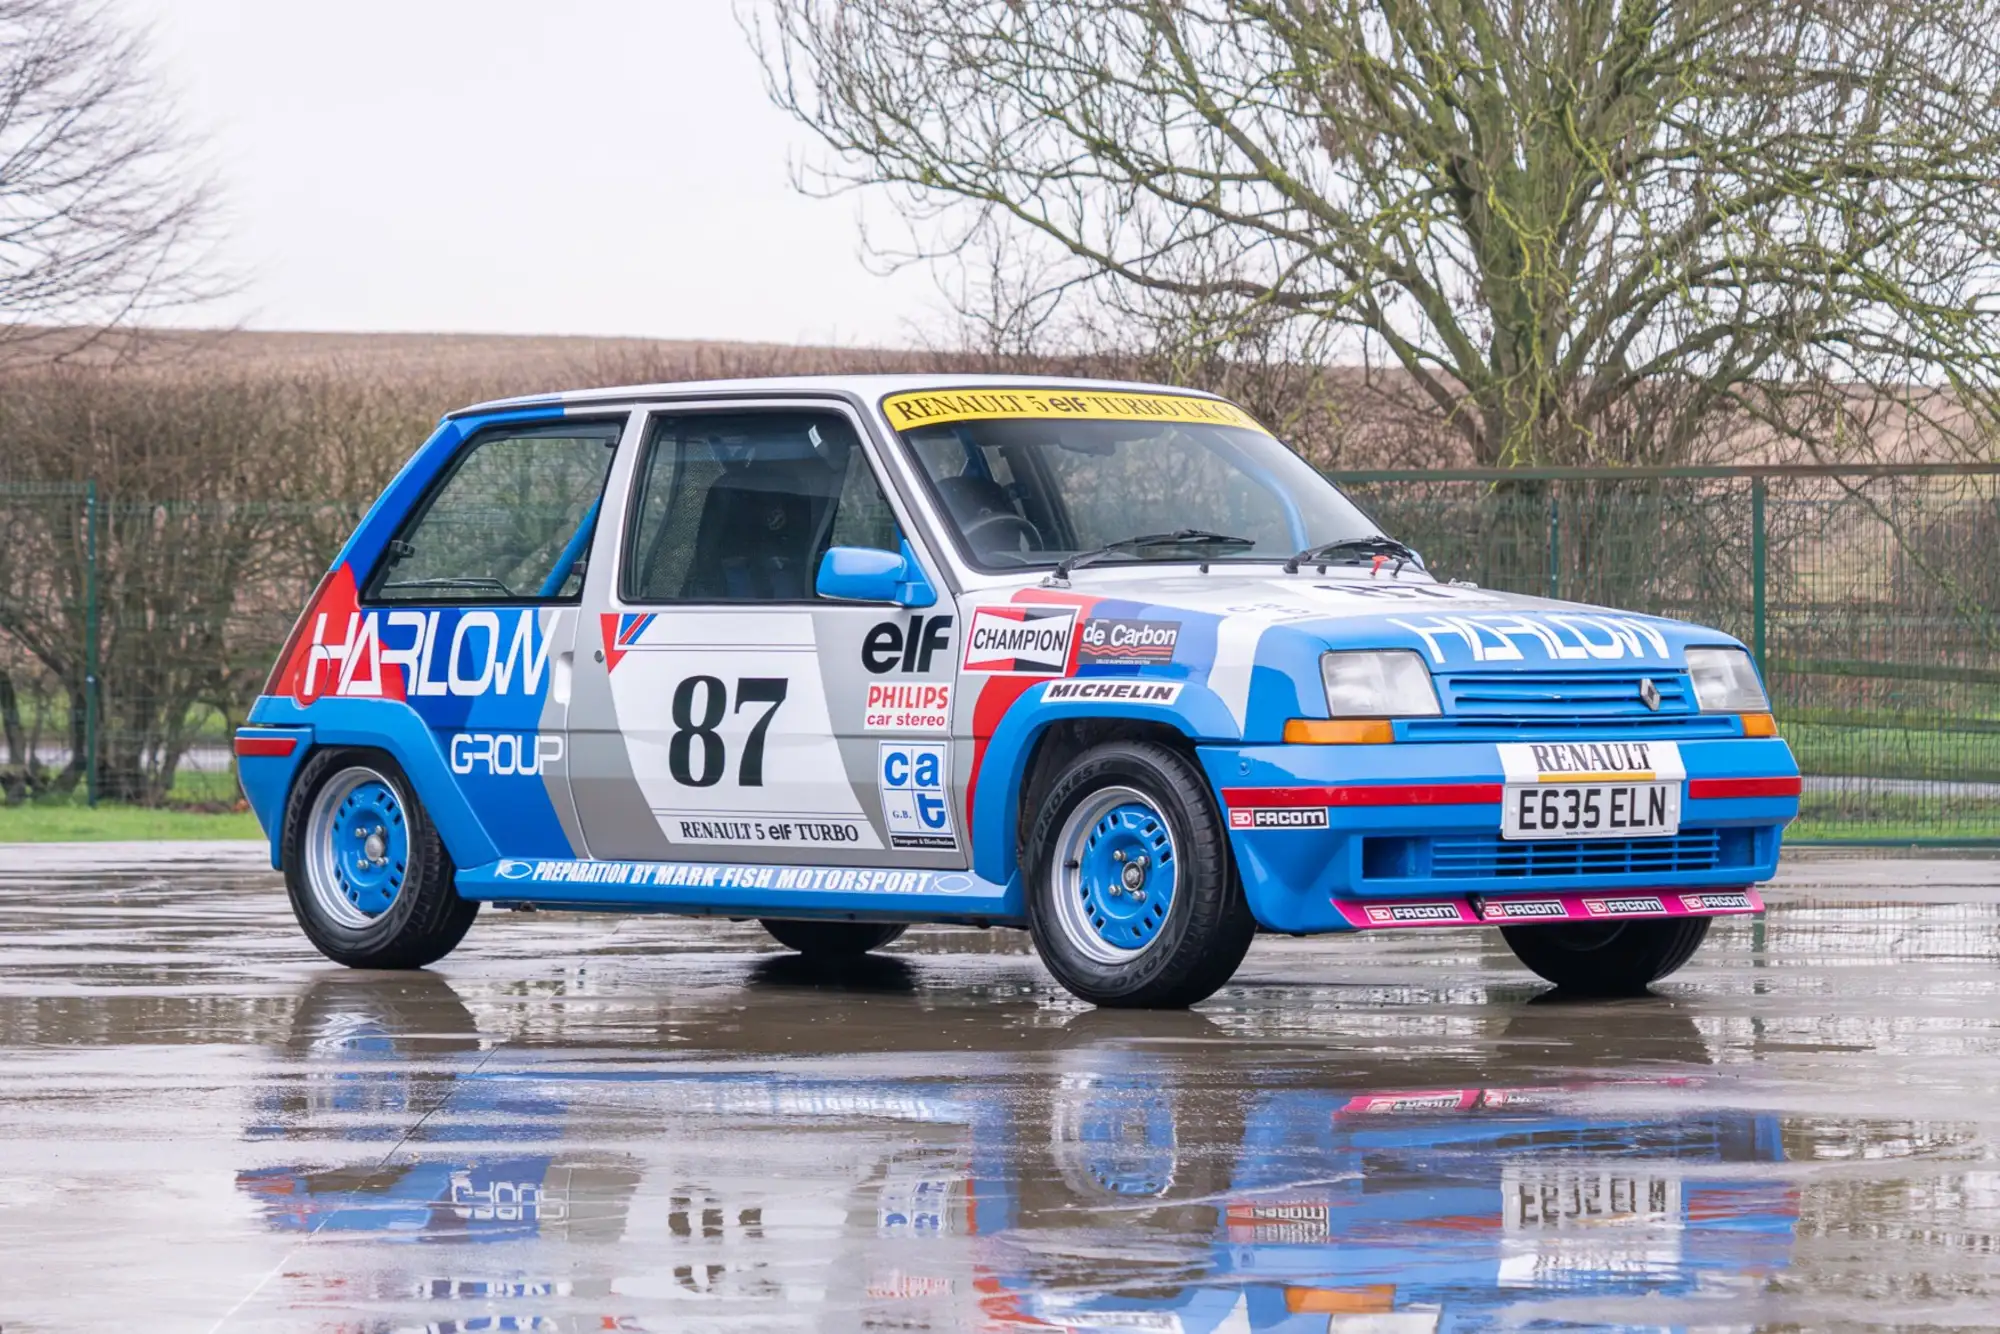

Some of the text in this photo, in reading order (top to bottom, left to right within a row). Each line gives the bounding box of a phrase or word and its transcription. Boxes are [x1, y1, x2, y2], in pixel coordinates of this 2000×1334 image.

[891, 395, 1023, 421] RENAULT
[1028, 396, 1045, 413] 5
[1051, 397, 1088, 413] elf
[1087, 397, 1179, 416] TURBO
[862, 615, 952, 674] elf
[973, 628, 1067, 651] CHAMPION
[1082, 622, 1178, 647] de Carbon
[1387, 614, 1670, 664] HARLOW
[304, 610, 561, 696] HARLOW
[867, 685, 949, 710] PHILIPS
[1048, 683, 1176, 700] MICHELIN
[669, 675, 789, 788] 87
[866, 712, 946, 727] car stereo
[451, 733, 564, 775] GROUP
[1529, 743, 1653, 772] RENAULT
[1256, 811, 1325, 825] FACOM
[1518, 782, 1667, 830] E635 ELN
[680, 821, 860, 843] RENAULT 5 elf TURBO
[531, 861, 932, 893] PREPARATION BY MARK FISH MOTORSPORT
[1395, 905, 1458, 918] FACOM
[1504, 902, 1563, 915] FACOM
[1607, 899, 1663, 911] FACOM
[1703, 894, 1751, 908] FACOM
